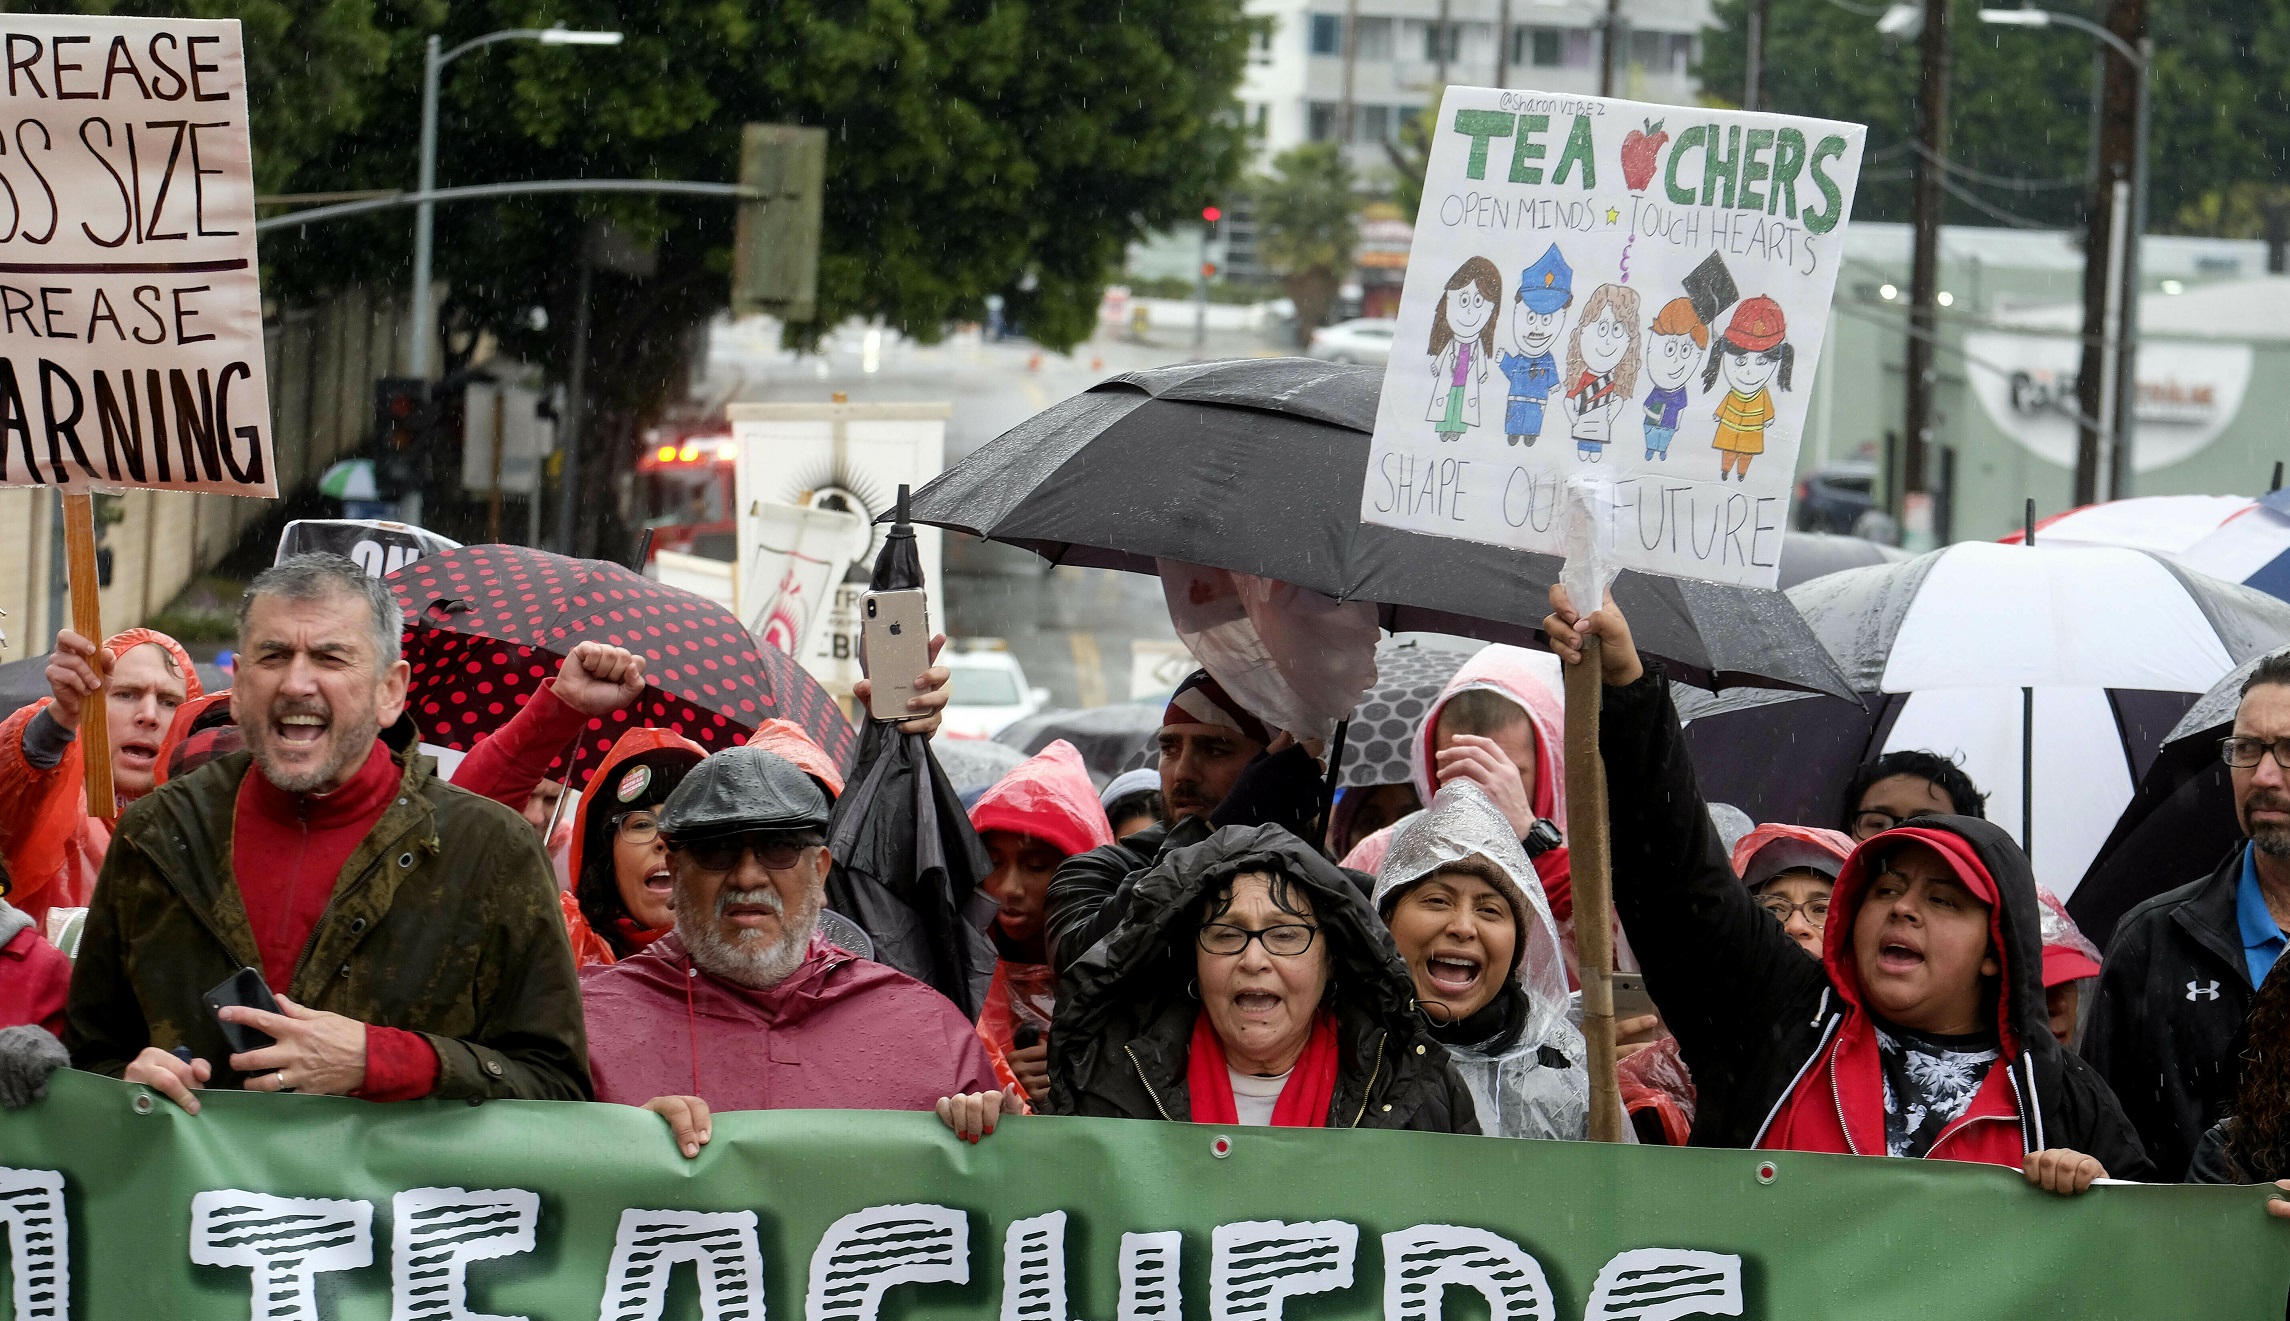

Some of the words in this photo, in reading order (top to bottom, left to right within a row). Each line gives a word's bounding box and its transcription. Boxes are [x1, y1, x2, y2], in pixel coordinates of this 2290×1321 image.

[6, 32, 230, 102] REASE
[80, 116, 239, 247] SIZE
[1440, 191, 1509, 229] OPEN
[1516, 197, 1595, 232] MINDS
[1631, 194, 1700, 248] TOUCH
[1711, 210, 1816, 276] HEARTS
[0, 284, 216, 345] REASE
[0, 356, 265, 484] ARNING
[1374, 452, 1470, 522] SHAPE
[1503, 466, 1566, 534] OU
[1612, 479, 1777, 568] FUTURE
